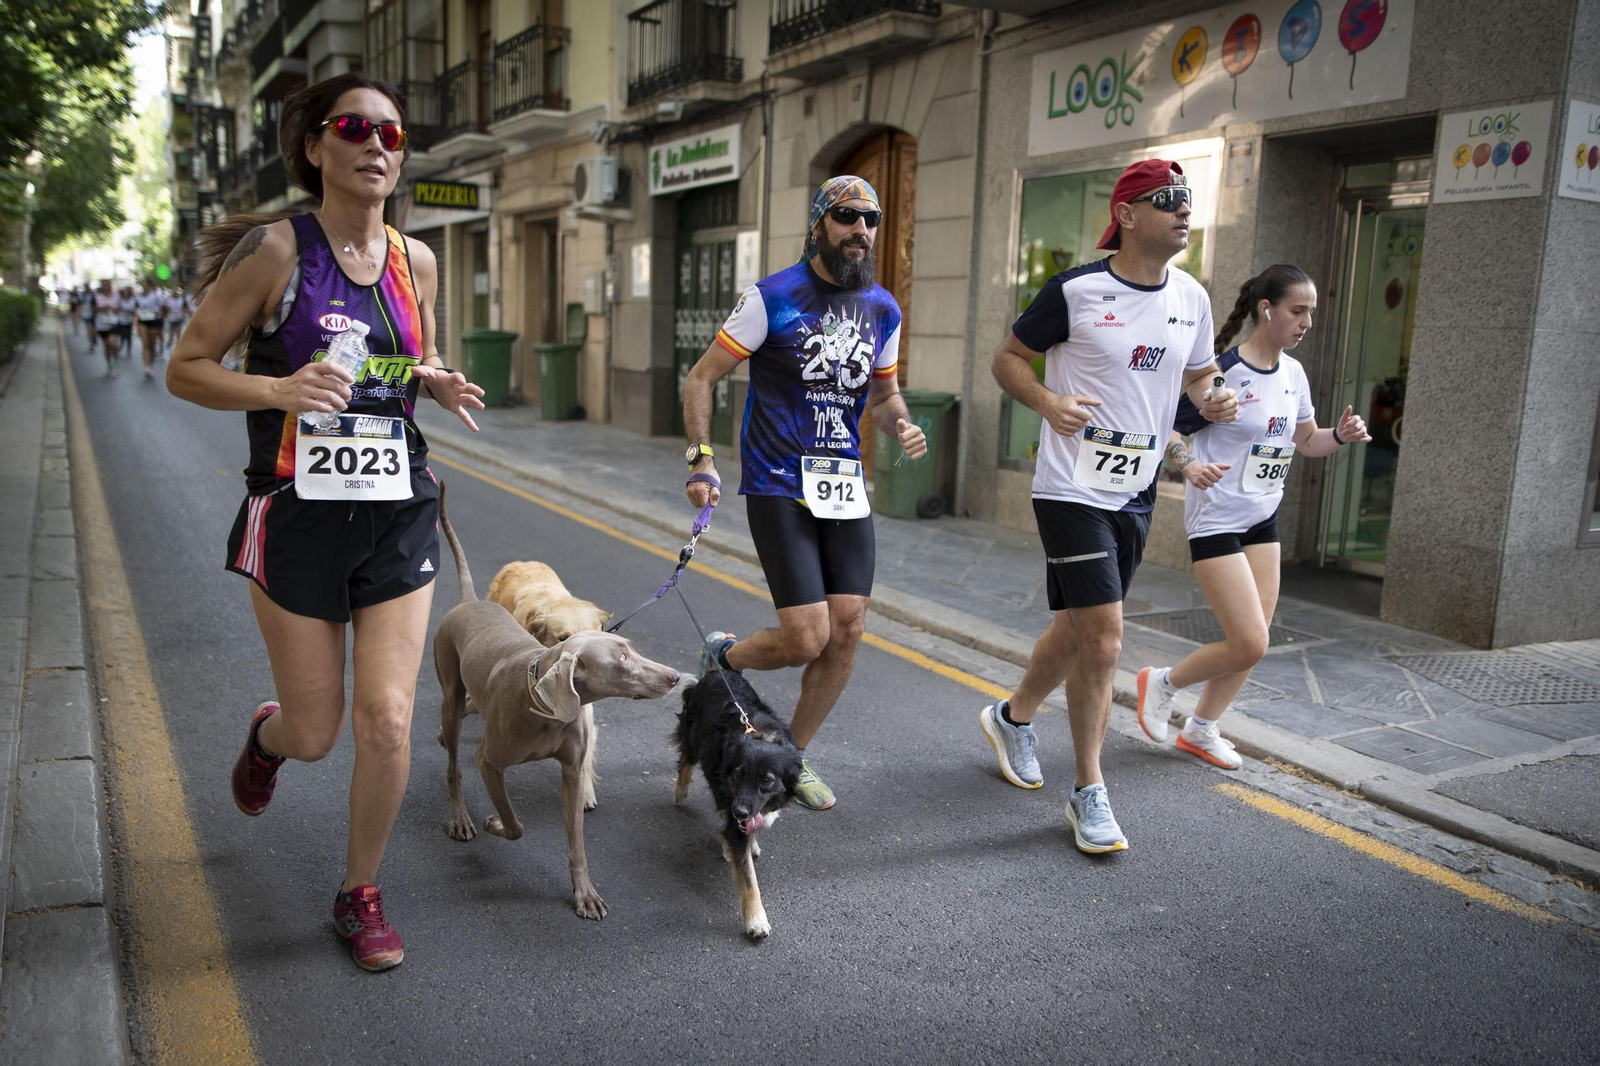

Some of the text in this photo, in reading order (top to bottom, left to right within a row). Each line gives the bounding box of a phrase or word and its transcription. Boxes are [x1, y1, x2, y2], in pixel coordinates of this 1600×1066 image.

[1048, 51, 1147, 124] LOOK
[1468, 112, 1521, 140] LOOK
[415, 181, 477, 207] PIZZERIA
[1444, 183, 1531, 195] PELUQUERÍA INFANTIL
[325, 317, 348, 329] KIA
[353, 417, 394, 435] GRANADA
[307, 446, 401, 476] 2023
[1095, 450, 1142, 476] 721
[1110, 477, 1125, 485] JESUS
[1256, 463, 1289, 480] 380
[344, 480, 375, 489] CRISTINA
[817, 480, 855, 502] 912
